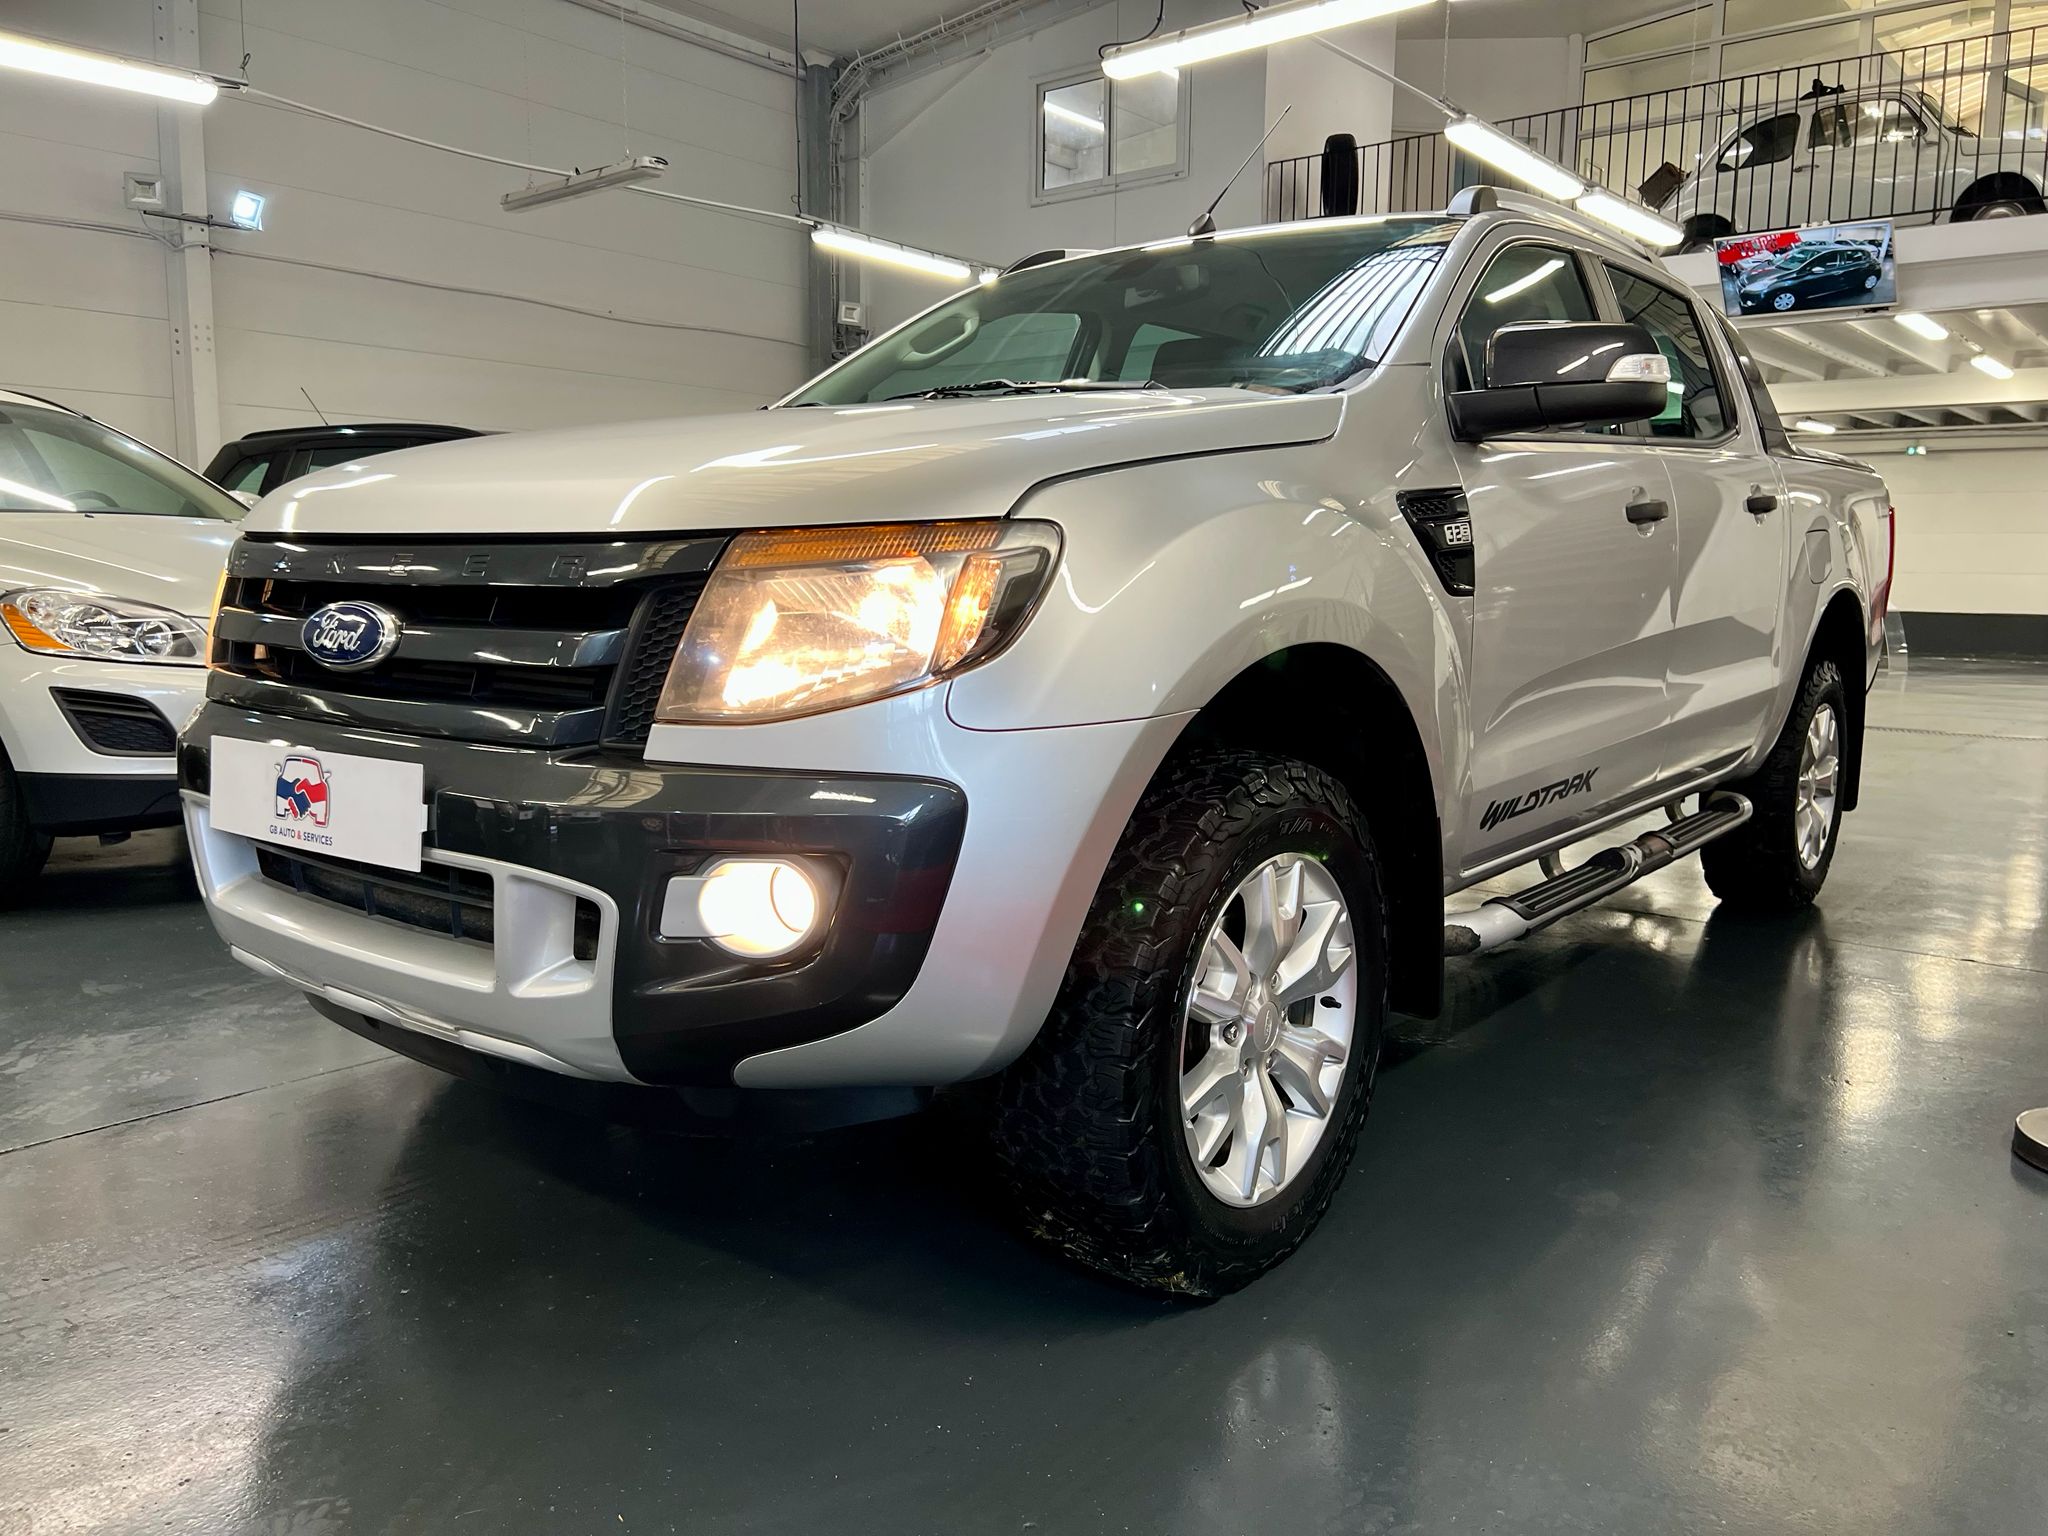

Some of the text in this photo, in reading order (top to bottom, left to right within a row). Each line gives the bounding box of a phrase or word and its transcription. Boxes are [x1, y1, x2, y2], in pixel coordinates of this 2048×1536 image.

[313, 611, 367, 651] Ford
[1480, 766, 1600, 832] WILDTRAK
[269, 824, 333, 846] GB AUTO & SERVICES
